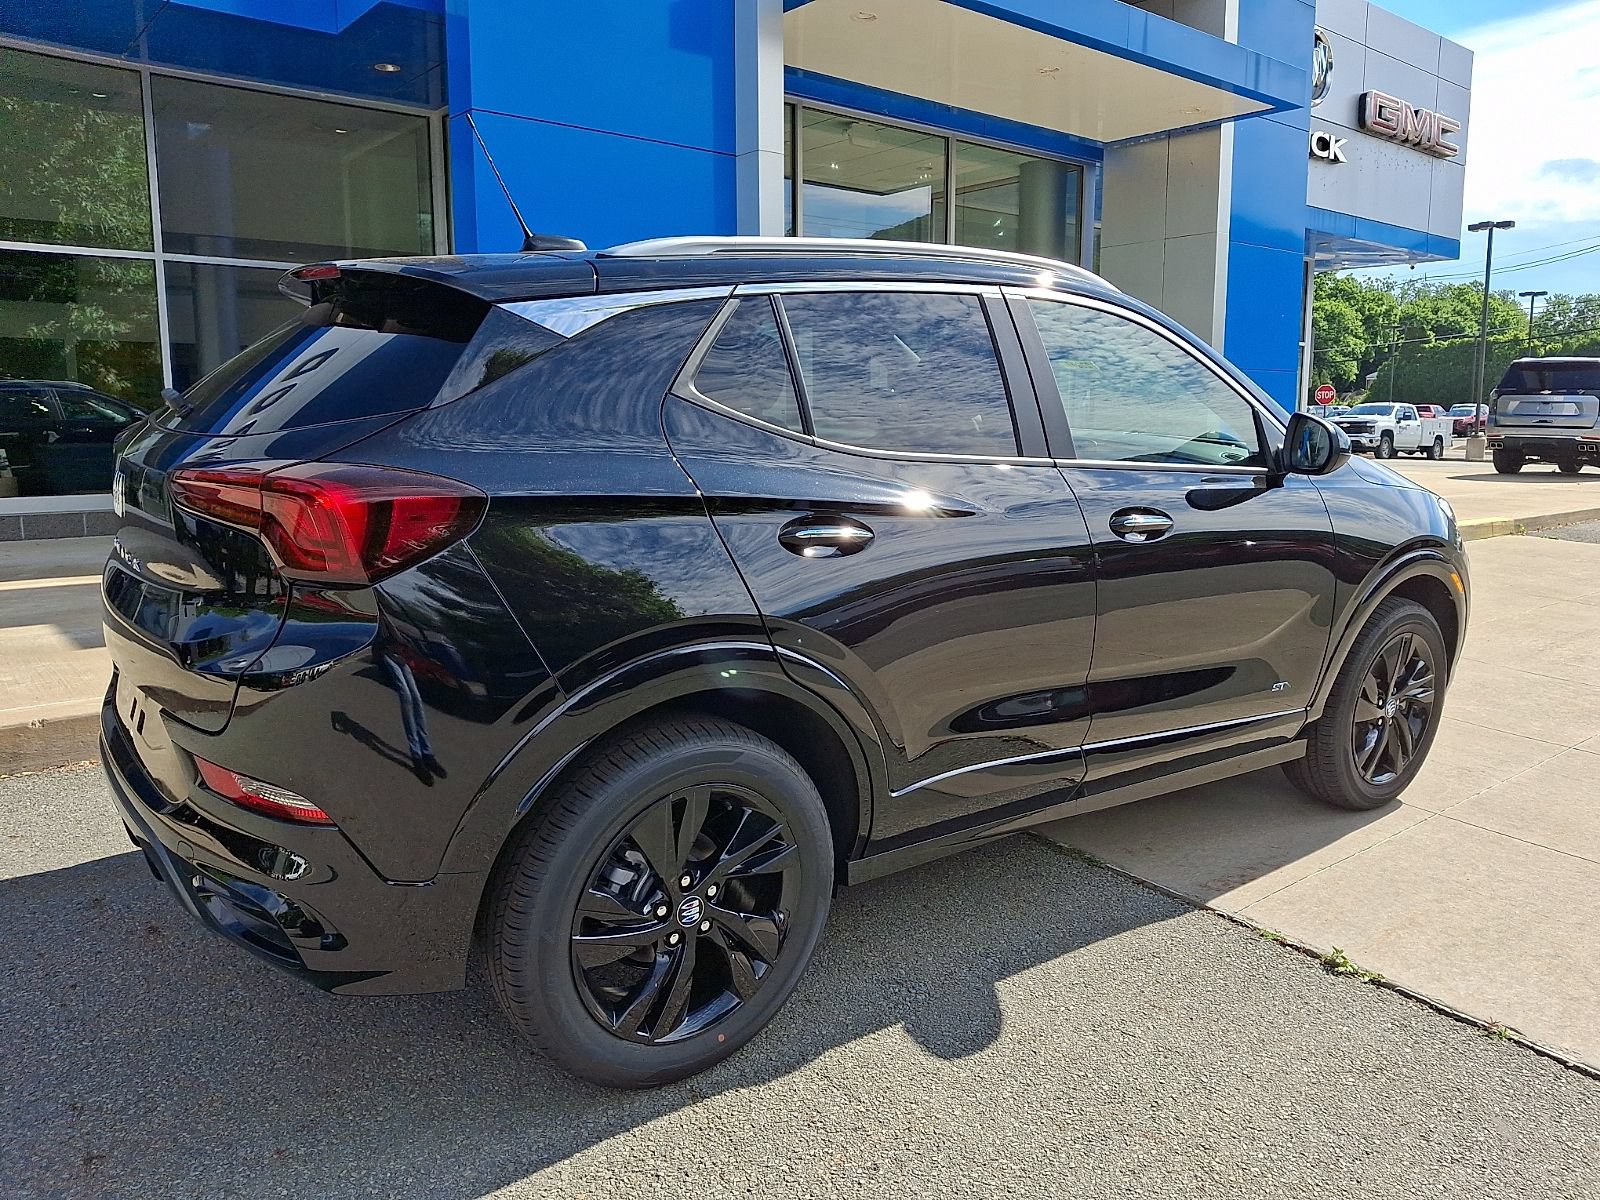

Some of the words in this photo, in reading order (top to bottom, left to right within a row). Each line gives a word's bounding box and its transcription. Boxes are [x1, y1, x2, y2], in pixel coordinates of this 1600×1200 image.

[1360, 89, 1460, 158] GMC
[1309, 130, 1348, 163] CK
[1316, 390, 1334, 400] STOP
[1271, 681, 1291, 692] ST
